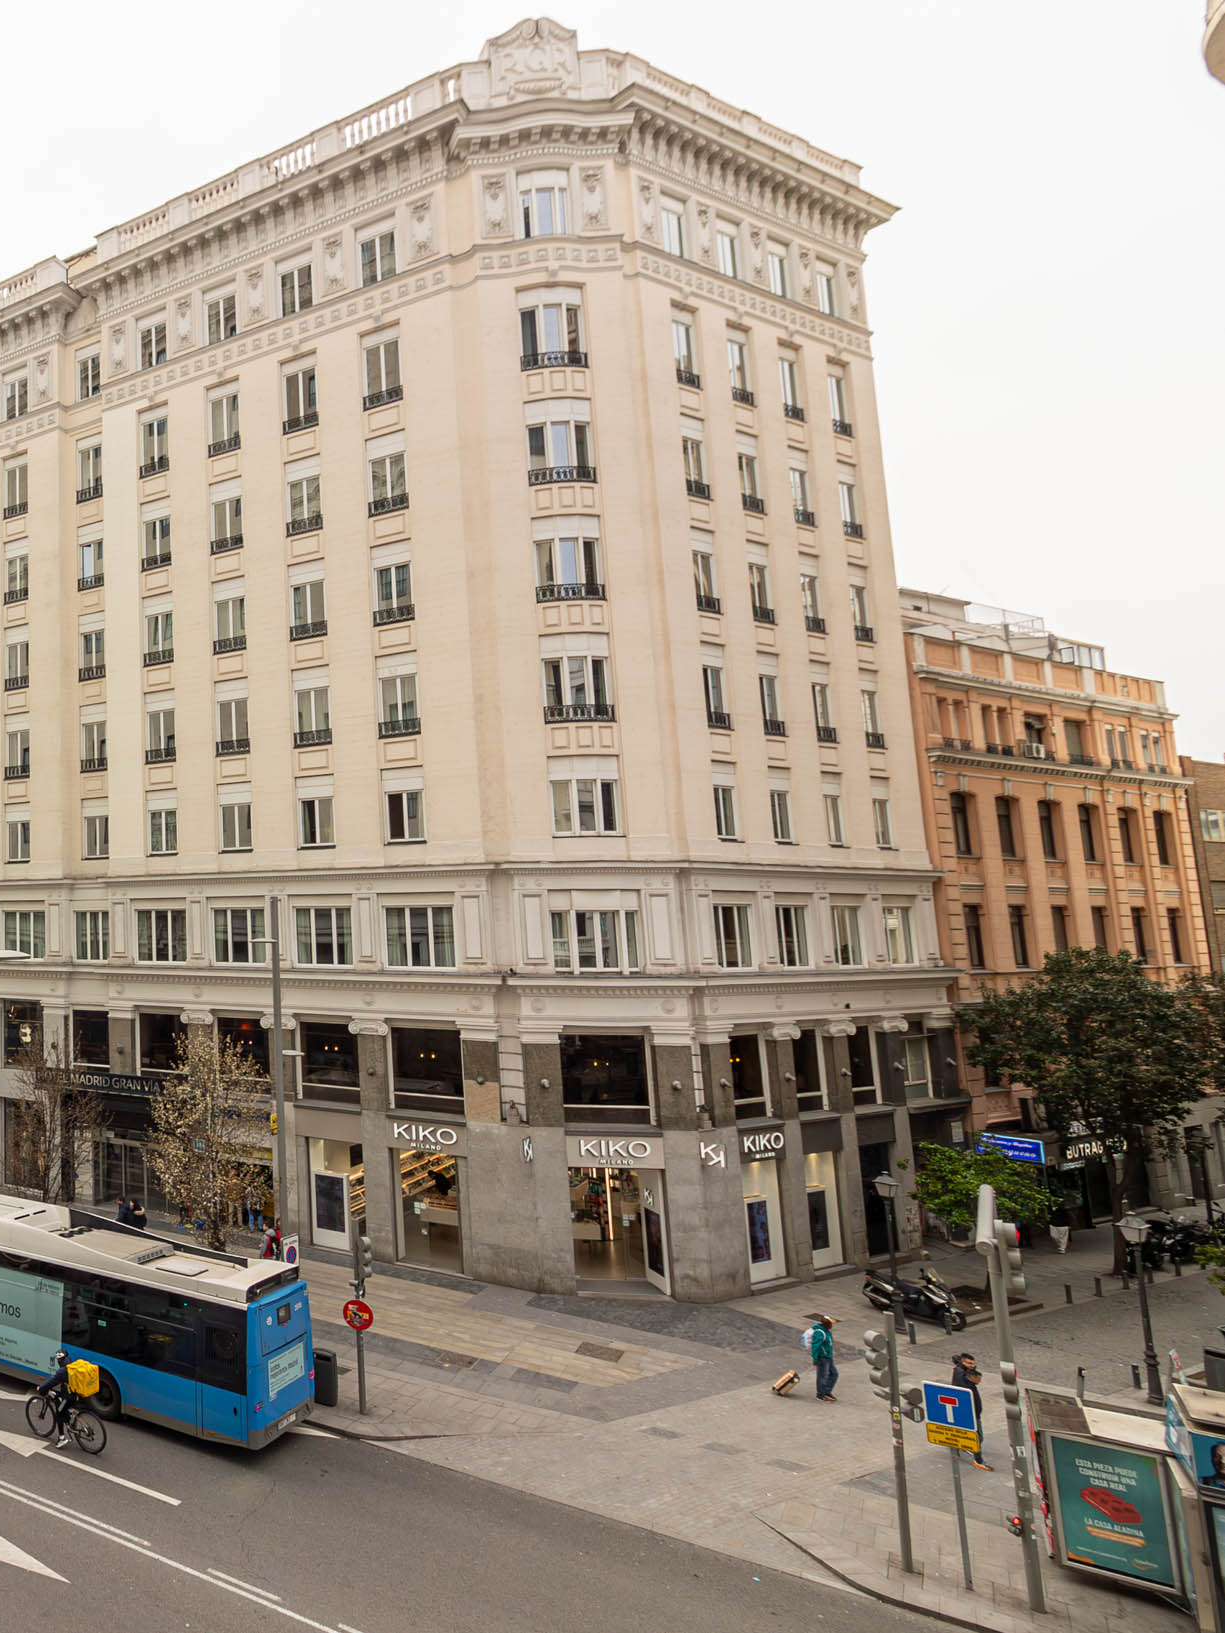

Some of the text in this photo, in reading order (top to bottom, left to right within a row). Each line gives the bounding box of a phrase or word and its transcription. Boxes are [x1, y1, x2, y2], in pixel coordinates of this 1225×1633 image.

[70, 1073, 111, 1088] MADRID
[112, 1077, 141, 1091] GRAN
[393, 1122, 458, 1145] KIKO
[743, 1132, 785, 1153] KIKO
[410, 1142, 441, 1151] MILANO
[579, 1139, 652, 1158] KIKO
[1075, 1458, 1137, 1478] ESTA PIEZA PUEDE
[1078, 1467, 1137, 1486] CONSTRUIR UNA
[1089, 1477, 1128, 1493] CASA REAL
[1084, 1517, 1145, 1538] LA CASA ALADINA
